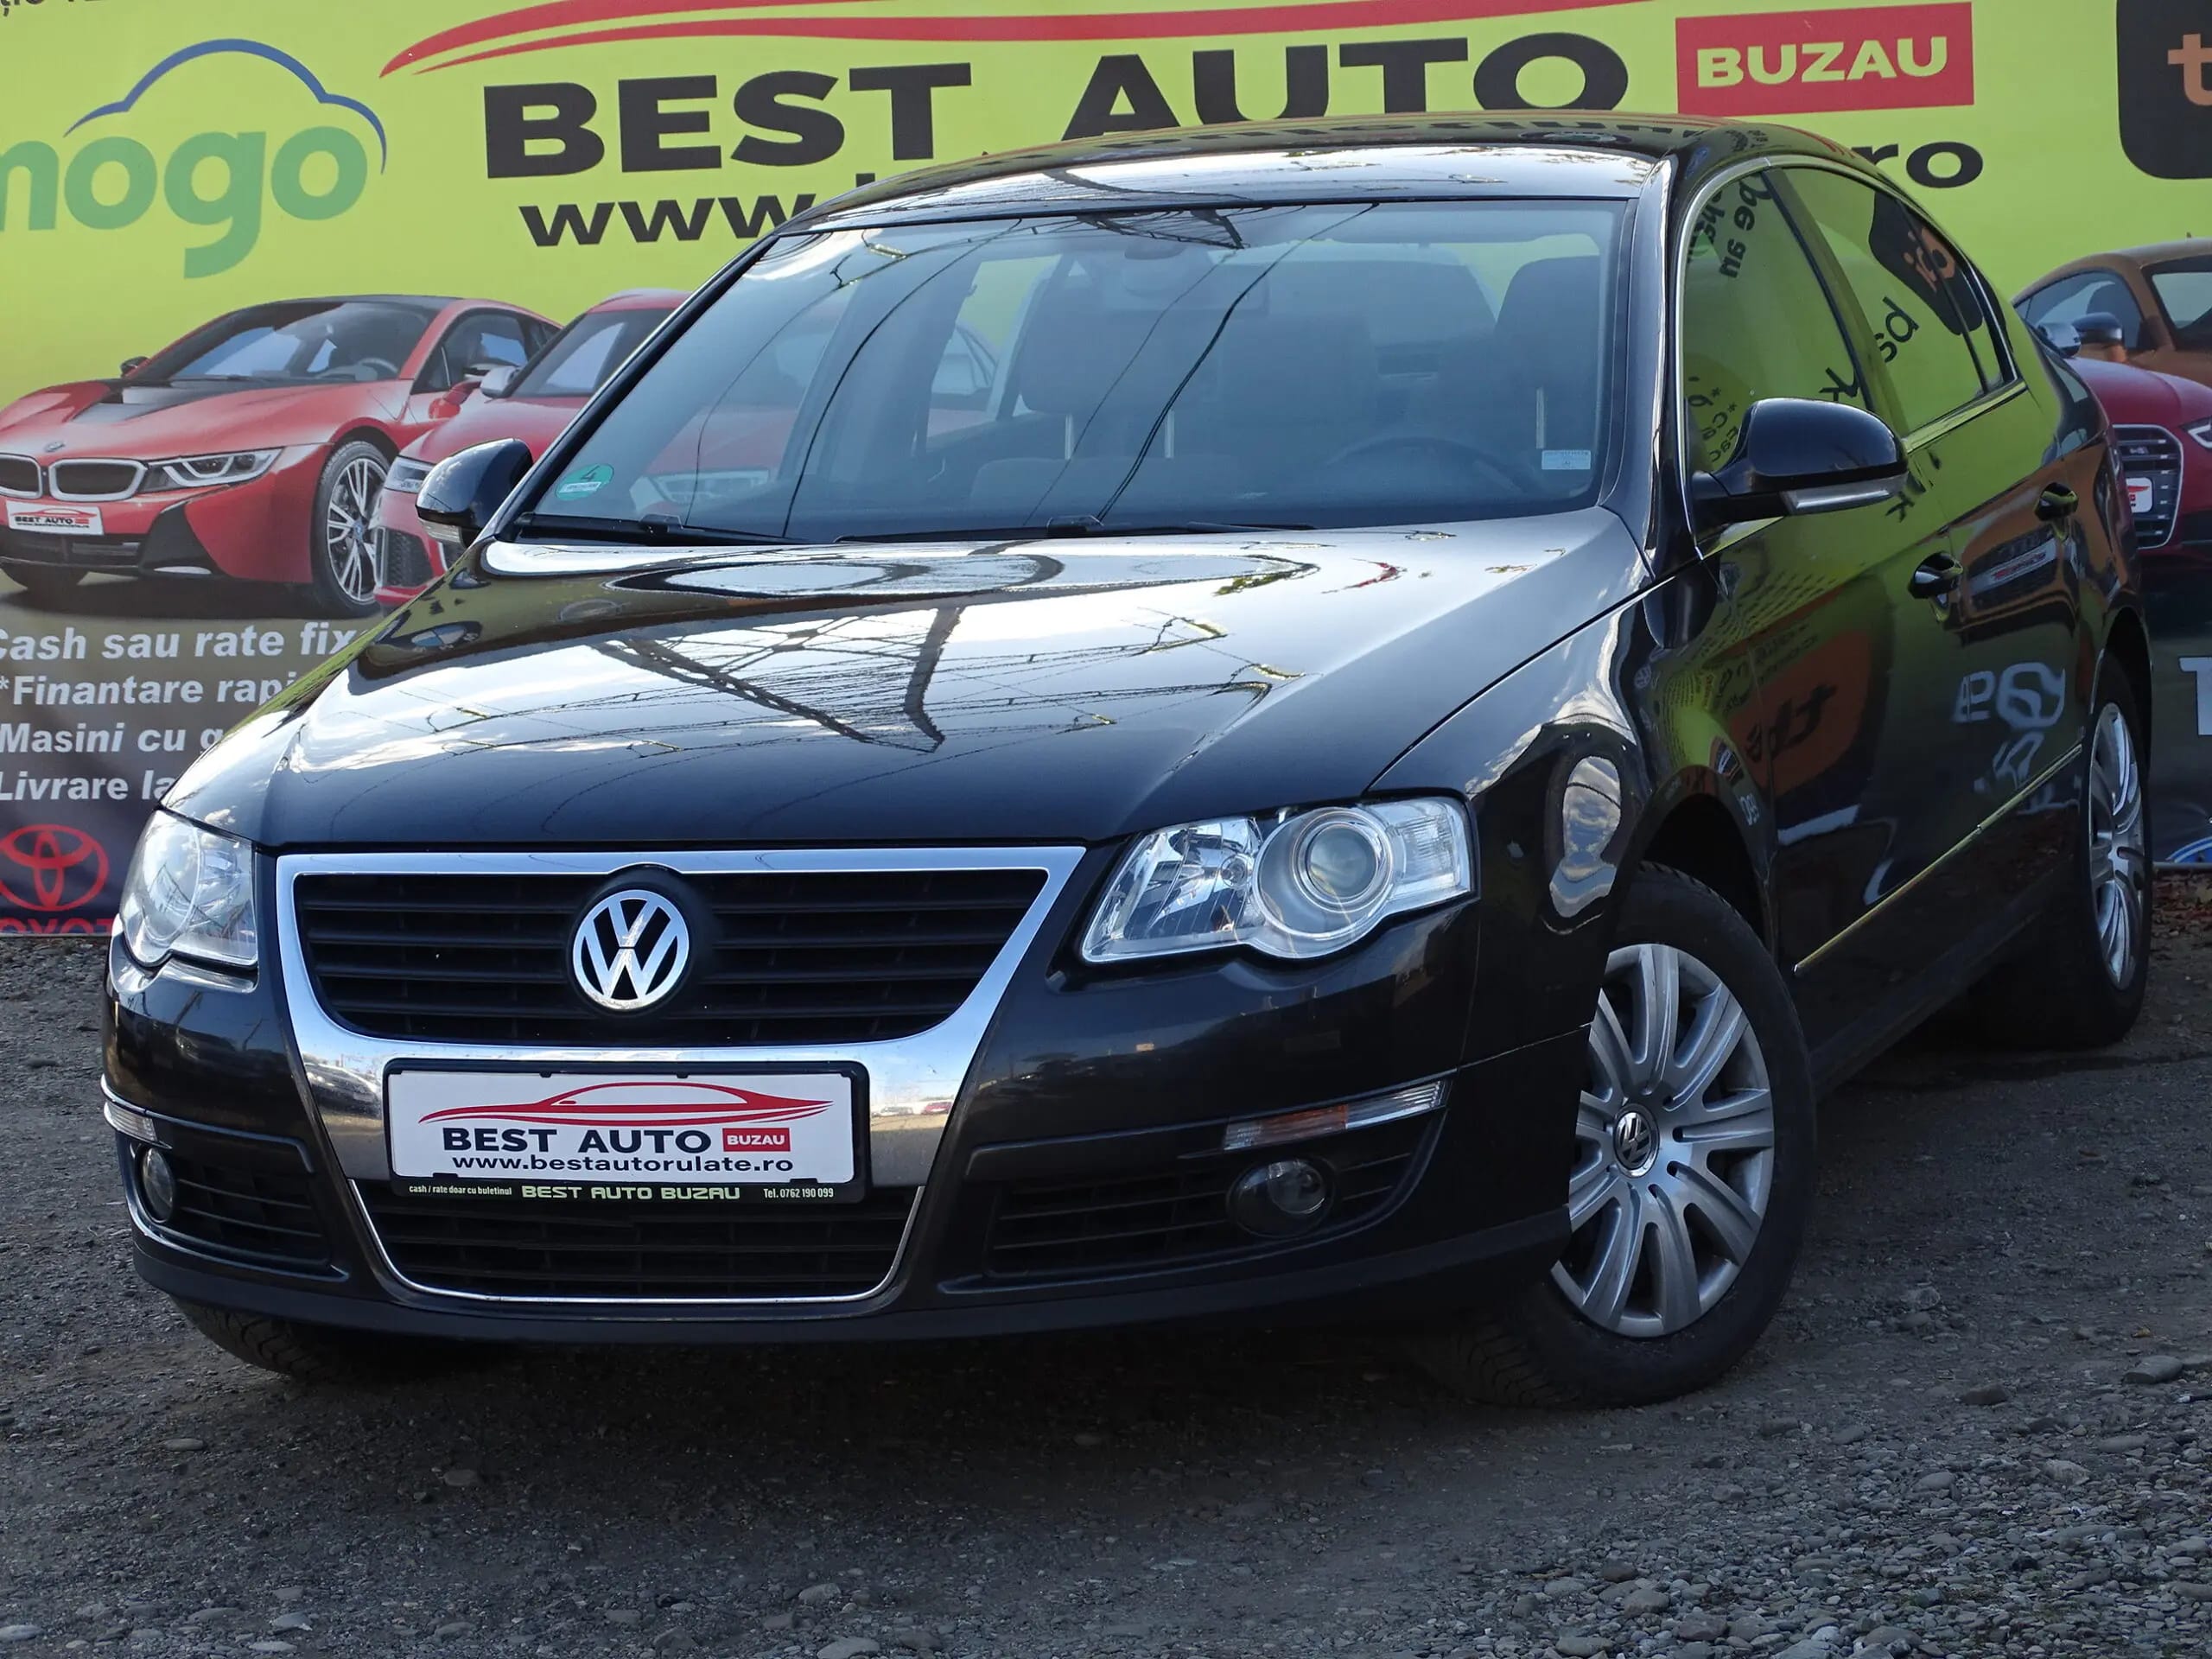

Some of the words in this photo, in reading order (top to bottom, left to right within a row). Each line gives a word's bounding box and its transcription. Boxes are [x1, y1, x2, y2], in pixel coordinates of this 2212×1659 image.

[1696, 36, 1948, 88] BUZAU
[484, 62, 972, 179] BEST
[1061, 32, 1629, 141] AUTO
[101, 633, 180, 659] sau
[194, 625, 285, 658] rate
[0, 722, 124, 753] Masini
[137, 728, 186, 752] cu
[442, 1128, 557, 1153] BEST
[578, 1129, 711, 1154] AUTO
[727, 1135, 785, 1146] BUZAU
[452, 1154, 794, 1172] www.bestautorulate.ro
[409, 1184, 427, 1193] cash
[432, 1185, 448, 1194] rate
[448, 1185, 467, 1195] doar
[467, 1186, 477, 1195] cu
[477, 1185, 512, 1196] buletinul
[521, 1185, 582, 1198] BEST
[590, 1186, 653, 1199] AUTO
[661, 1187, 741, 1200] BUZAU
[763, 1187, 779, 1198] Tel.
[779, 1187, 801, 1198] 0762
[801, 1187, 817, 1198] 190
[817, 1186, 834, 1198] 099
